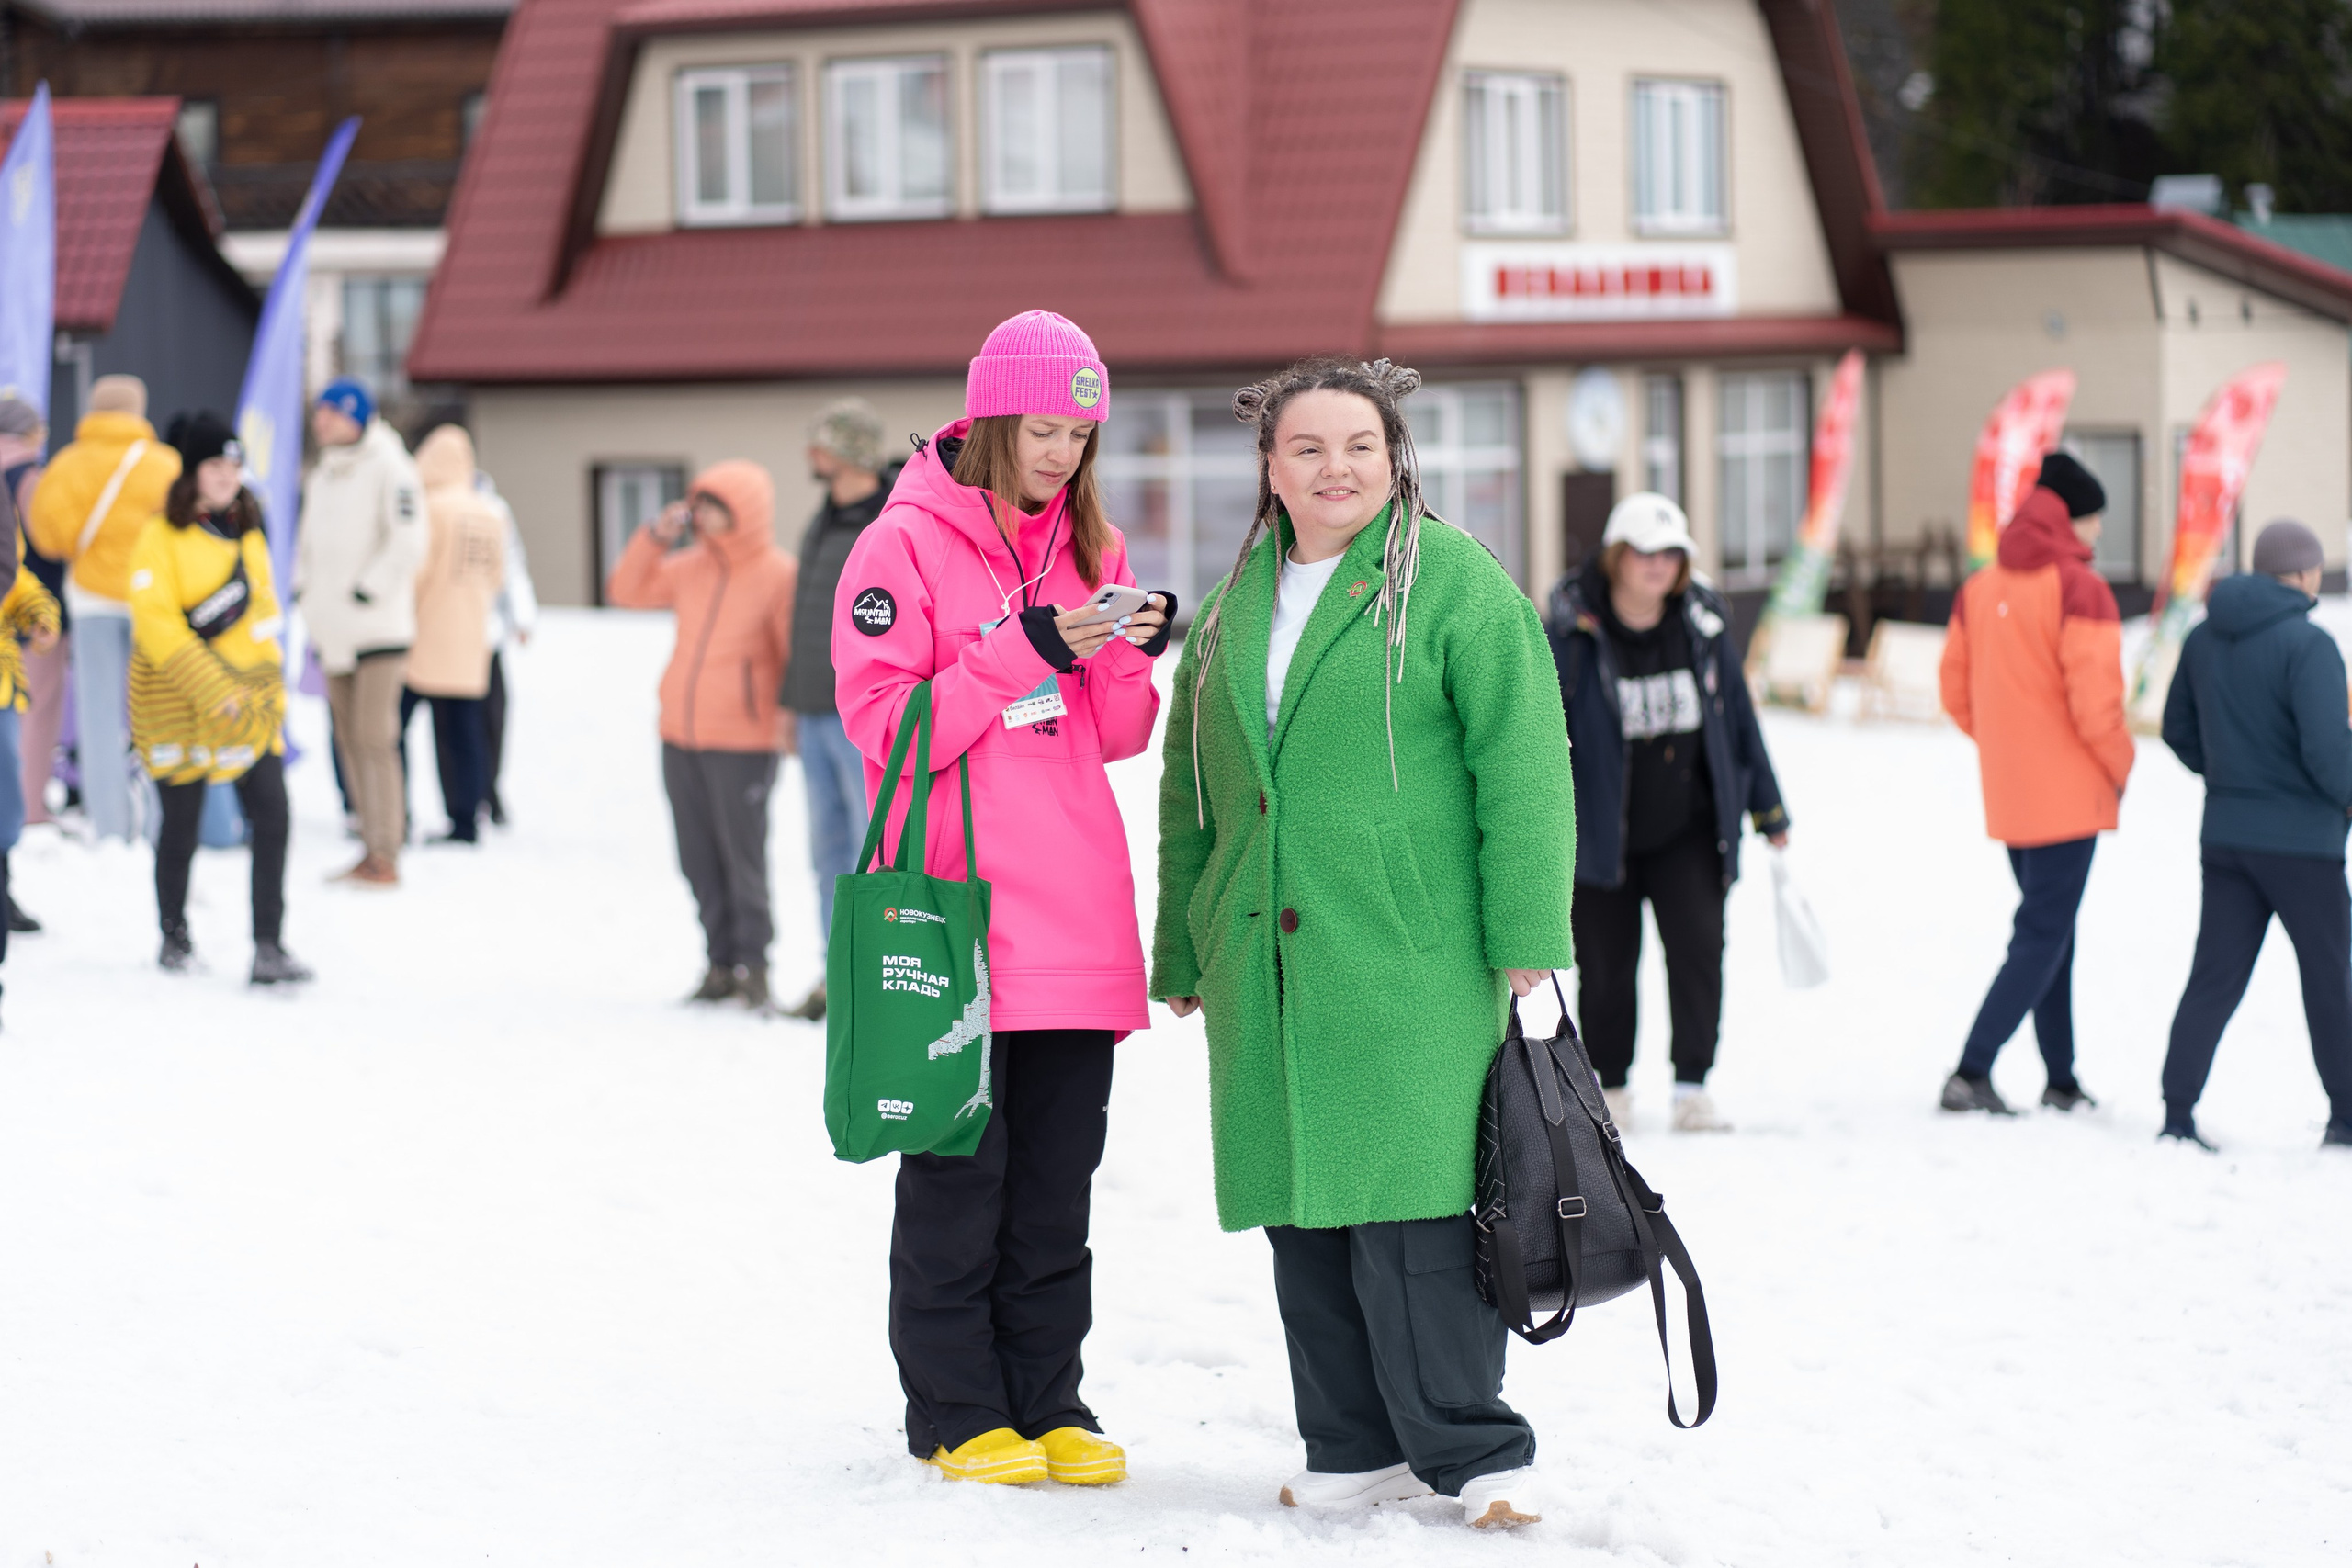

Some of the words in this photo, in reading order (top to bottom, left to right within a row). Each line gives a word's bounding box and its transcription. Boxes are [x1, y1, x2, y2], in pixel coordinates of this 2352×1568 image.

[1075, 387, 1092, 398] FEST
[854, 608, 891, 617] MOUNTAIN
[874, 616, 891, 626] MAN
[1042, 726, 1058, 737] MAN
[899, 908, 946, 924] НОВОКУЗНЕЦК
[882, 955, 922, 968] МОЯ
[882, 967, 950, 987] РУЧНАЯ
[882, 980, 941, 998] КЛАДЬ
